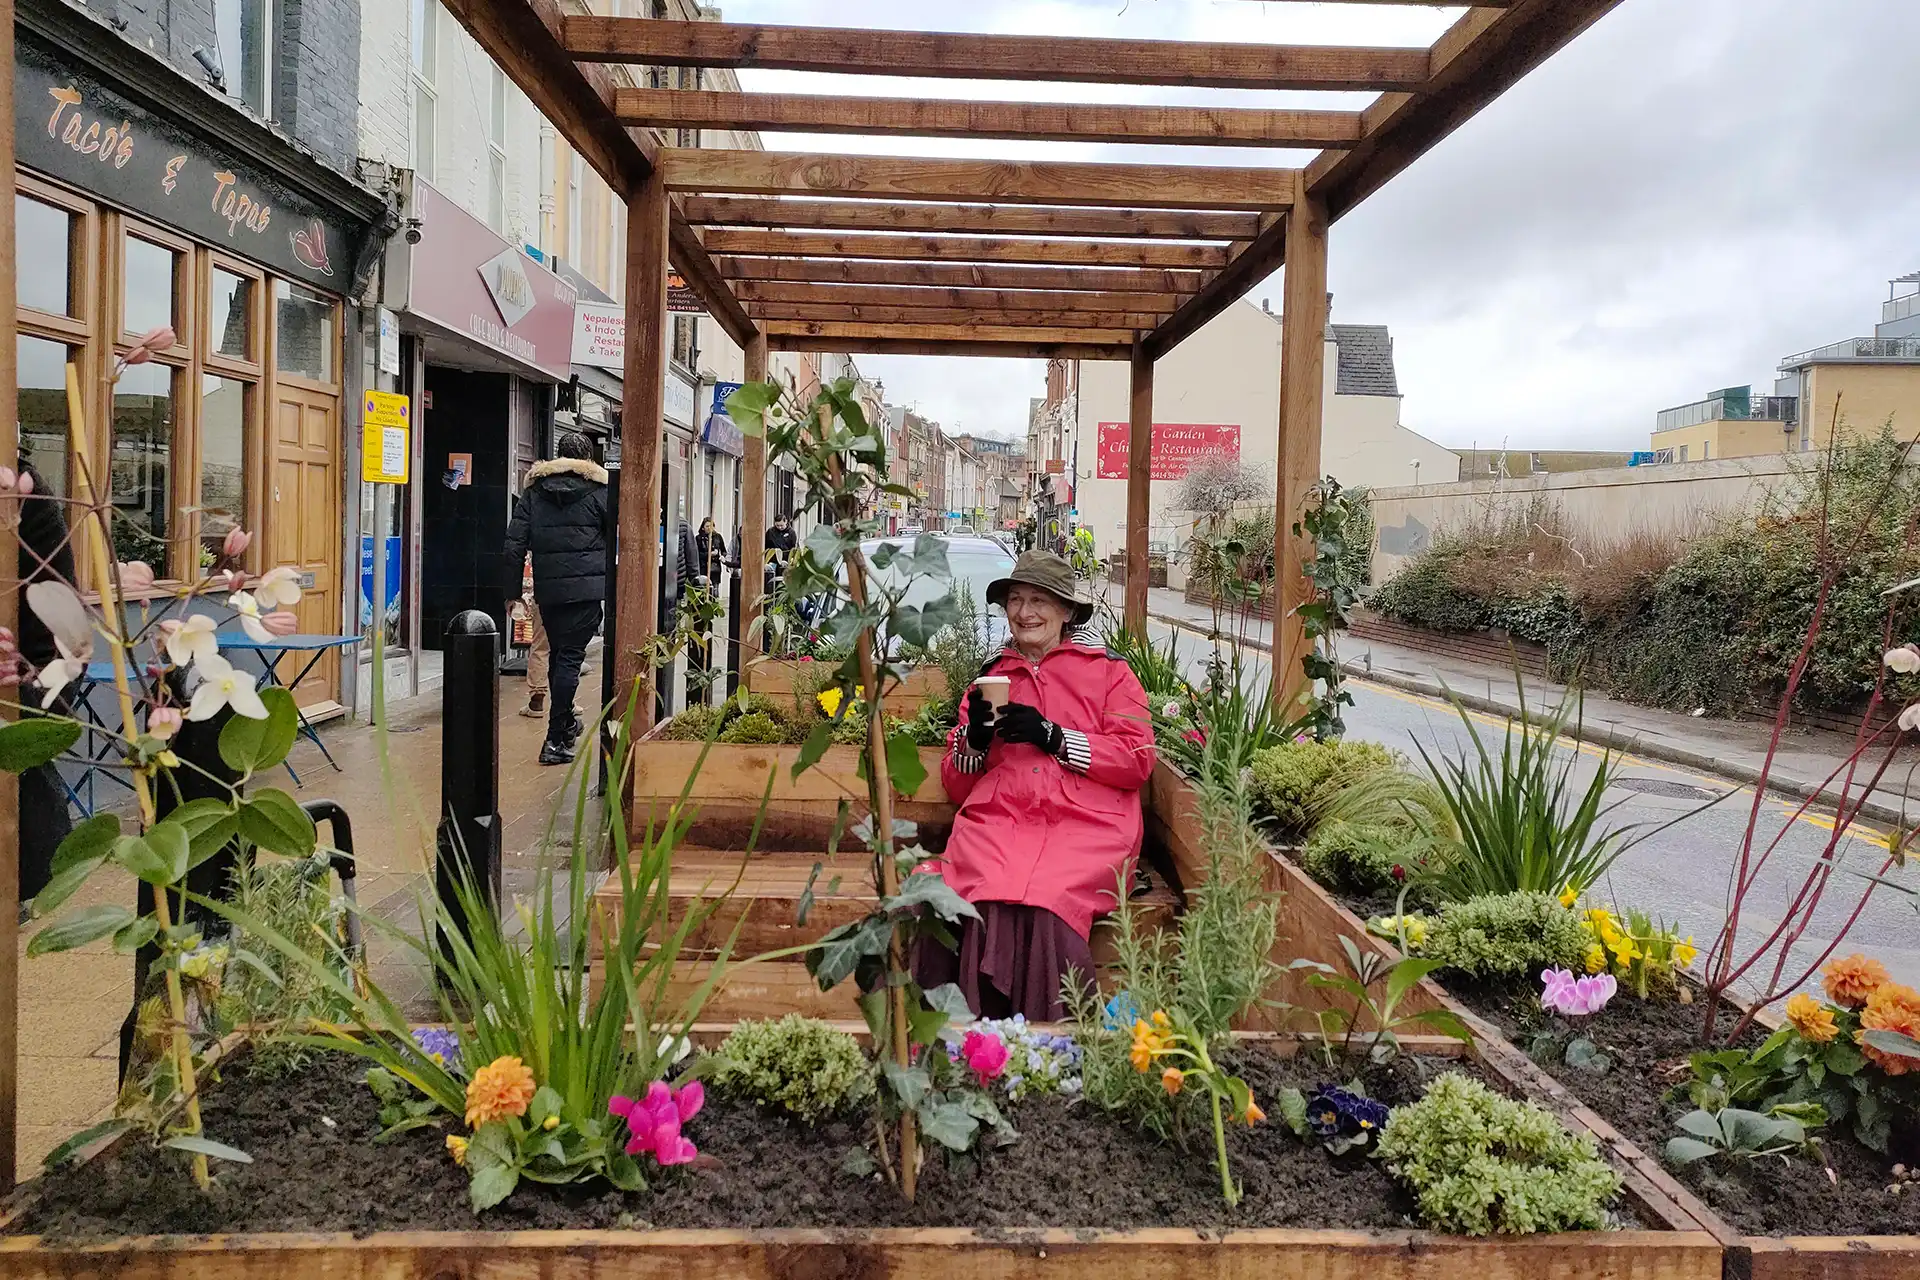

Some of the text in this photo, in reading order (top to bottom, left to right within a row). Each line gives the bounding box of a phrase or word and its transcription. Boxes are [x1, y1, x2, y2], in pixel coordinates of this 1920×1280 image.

[48, 85, 134, 169] Taco's
[212, 169, 271, 237] Tapas
[583, 313, 625, 326] Nepalese
[584, 324, 591, 332] &
[594, 325, 616, 335] Indo
[588, 346, 621, 357] & Take
[1162, 426, 1205, 440] Garden
